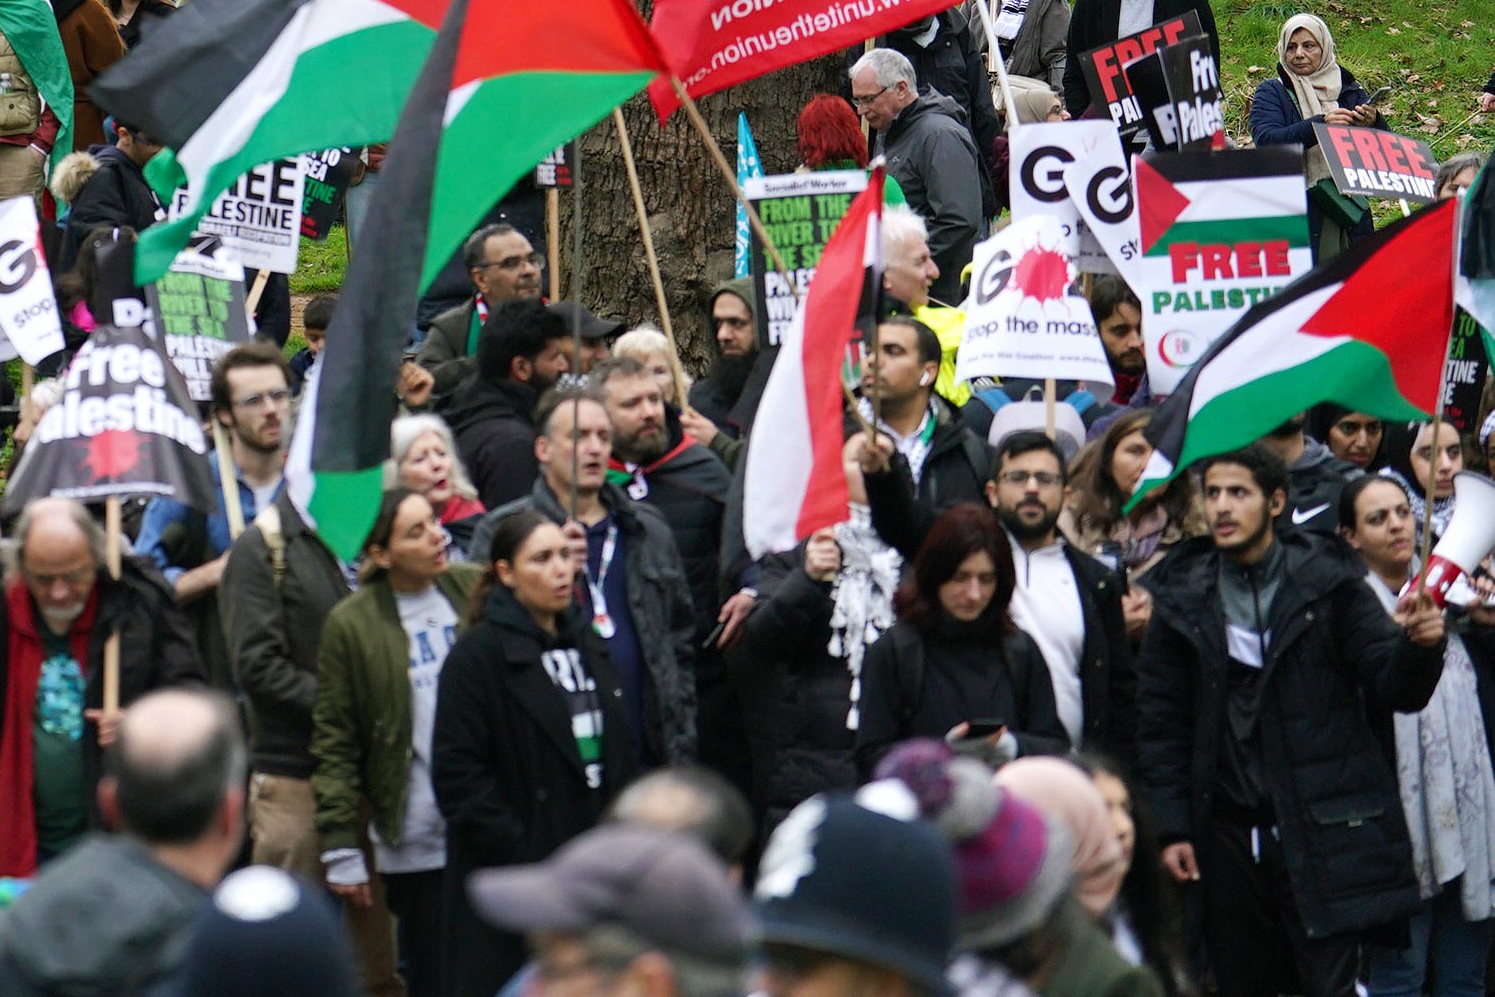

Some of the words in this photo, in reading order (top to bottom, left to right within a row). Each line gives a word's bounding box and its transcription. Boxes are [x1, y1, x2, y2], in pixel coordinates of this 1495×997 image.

[1327, 126, 1434, 180] FREE
[759, 195, 812, 225] FROM
[1168, 240, 1291, 285] FREE
[1005, 315, 1039, 335] the
[38, 384, 206, 455] alestine
